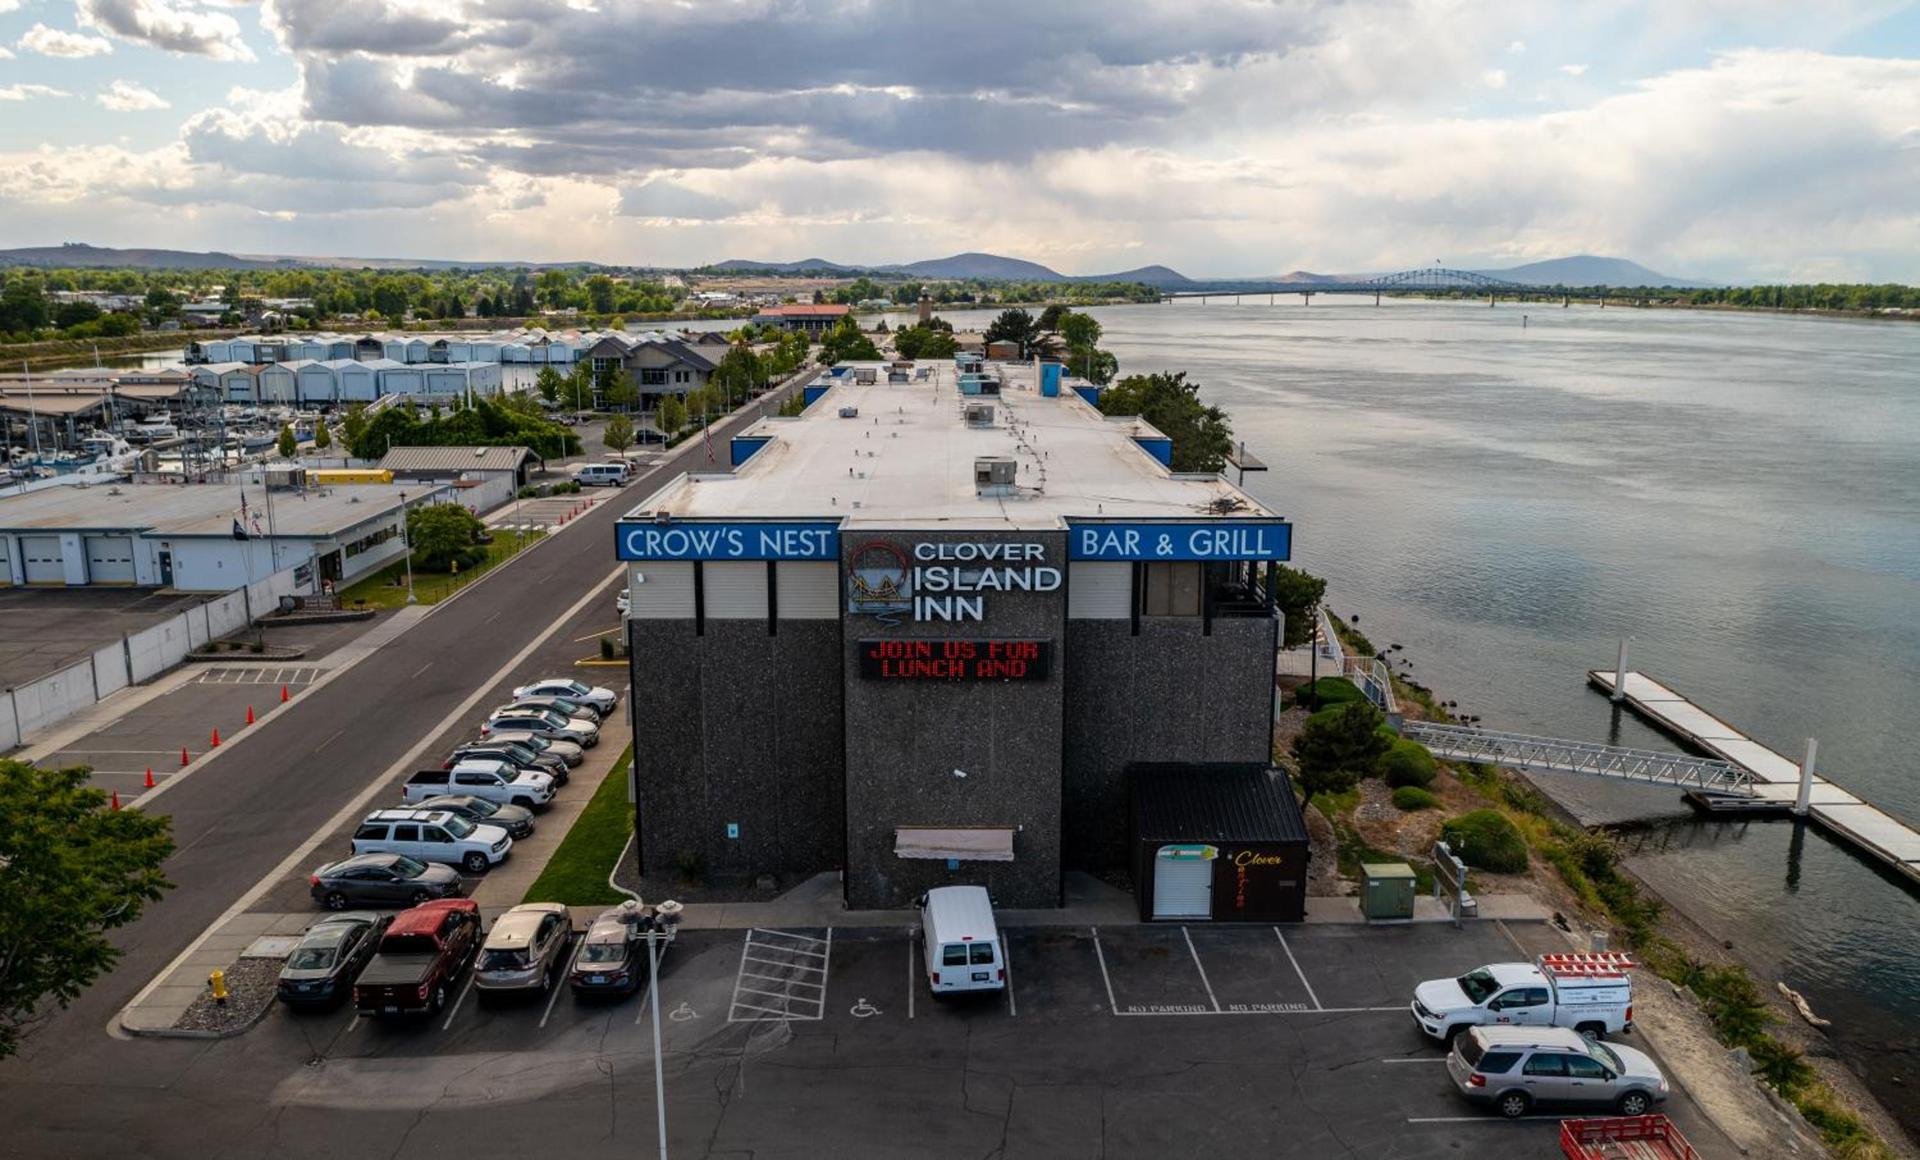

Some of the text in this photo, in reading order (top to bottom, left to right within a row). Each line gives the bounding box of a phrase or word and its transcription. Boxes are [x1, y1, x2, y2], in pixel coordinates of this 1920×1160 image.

[627, 527, 832, 556] CROW'S NEST
[1082, 529, 1272, 556] BAR & GRILL
[914, 542, 1045, 561] CLOVER
[914, 566, 1062, 591] ISLAND
[914, 596, 983, 621] INN
[869, 639, 931, 659] JOIN
[944, 639, 977, 659] US
[882, 659, 1027, 678] LUNCH AND
[1235, 850, 1282, 866] Clover
[1128, 1004, 1146, 1013] NO
[1229, 1003, 1308, 1012] NO PARKING
